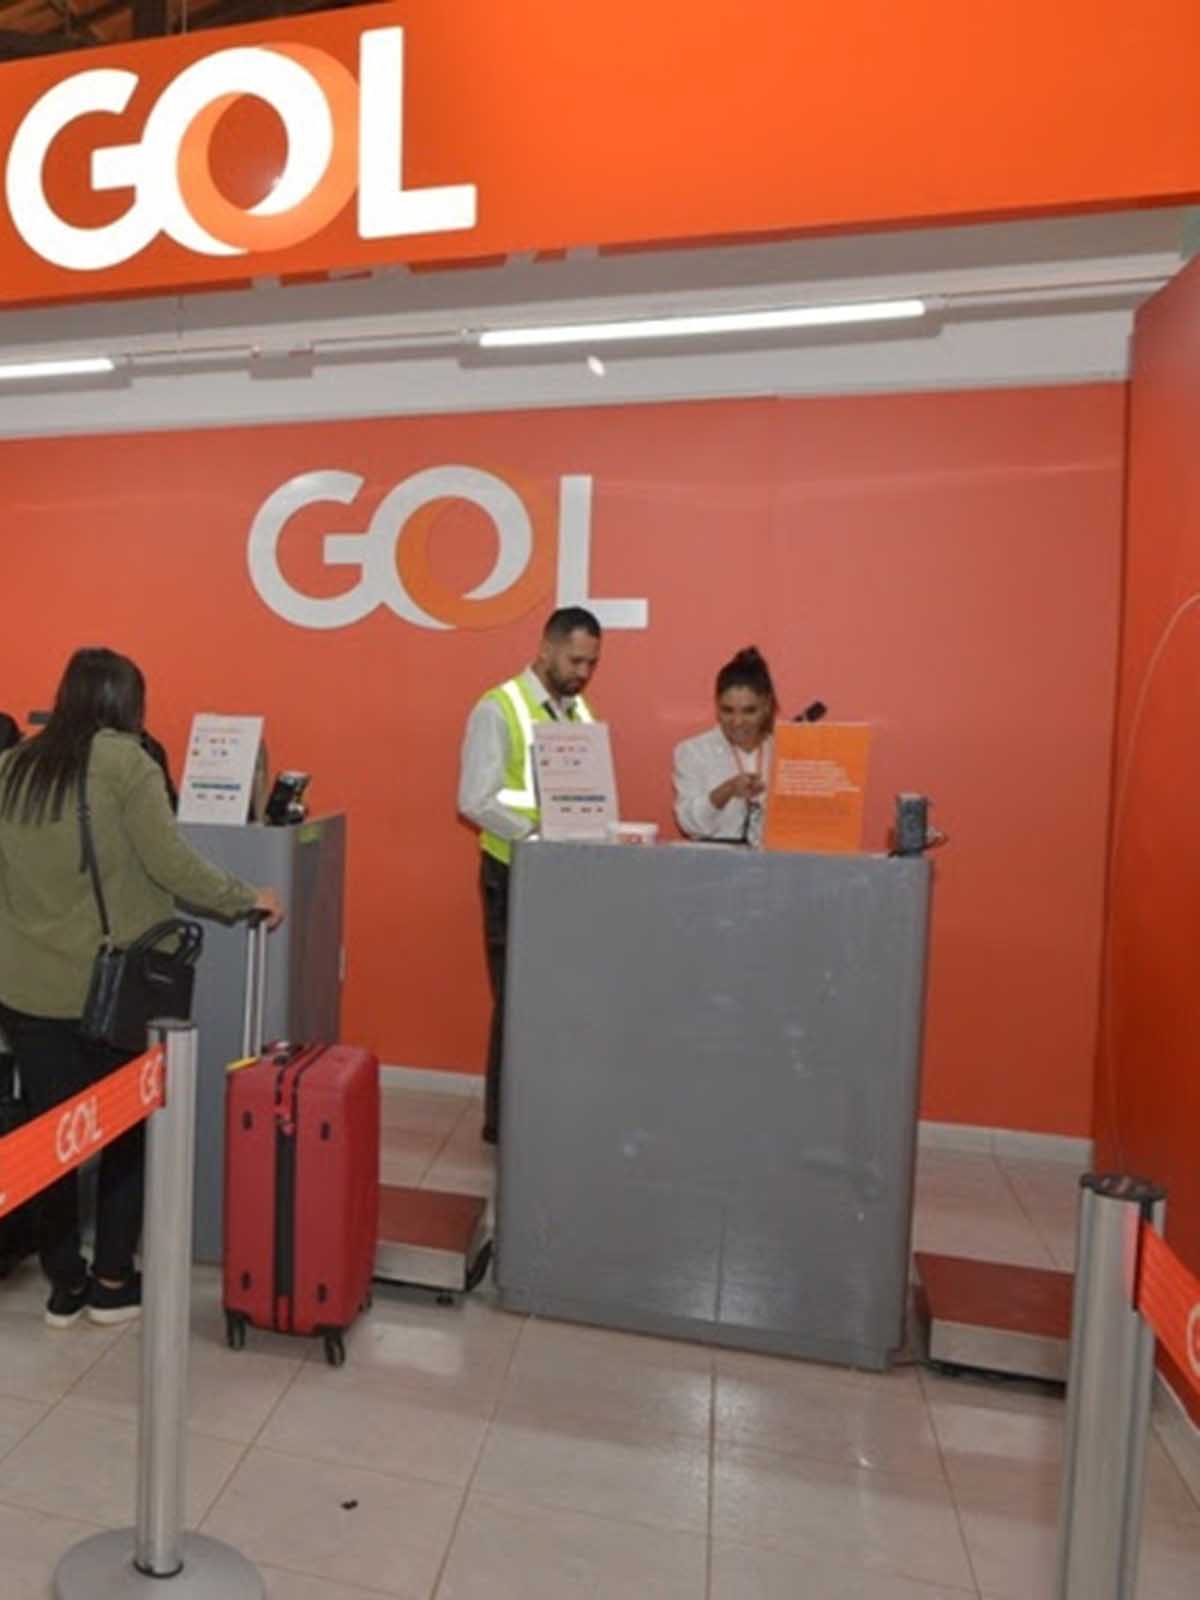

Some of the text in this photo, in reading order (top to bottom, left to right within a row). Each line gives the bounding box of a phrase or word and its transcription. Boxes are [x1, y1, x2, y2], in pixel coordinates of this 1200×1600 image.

[5, 26, 477, 271] GOL
[246, 464, 649, 631] GOL
[55, 1095, 103, 1164] GOL
